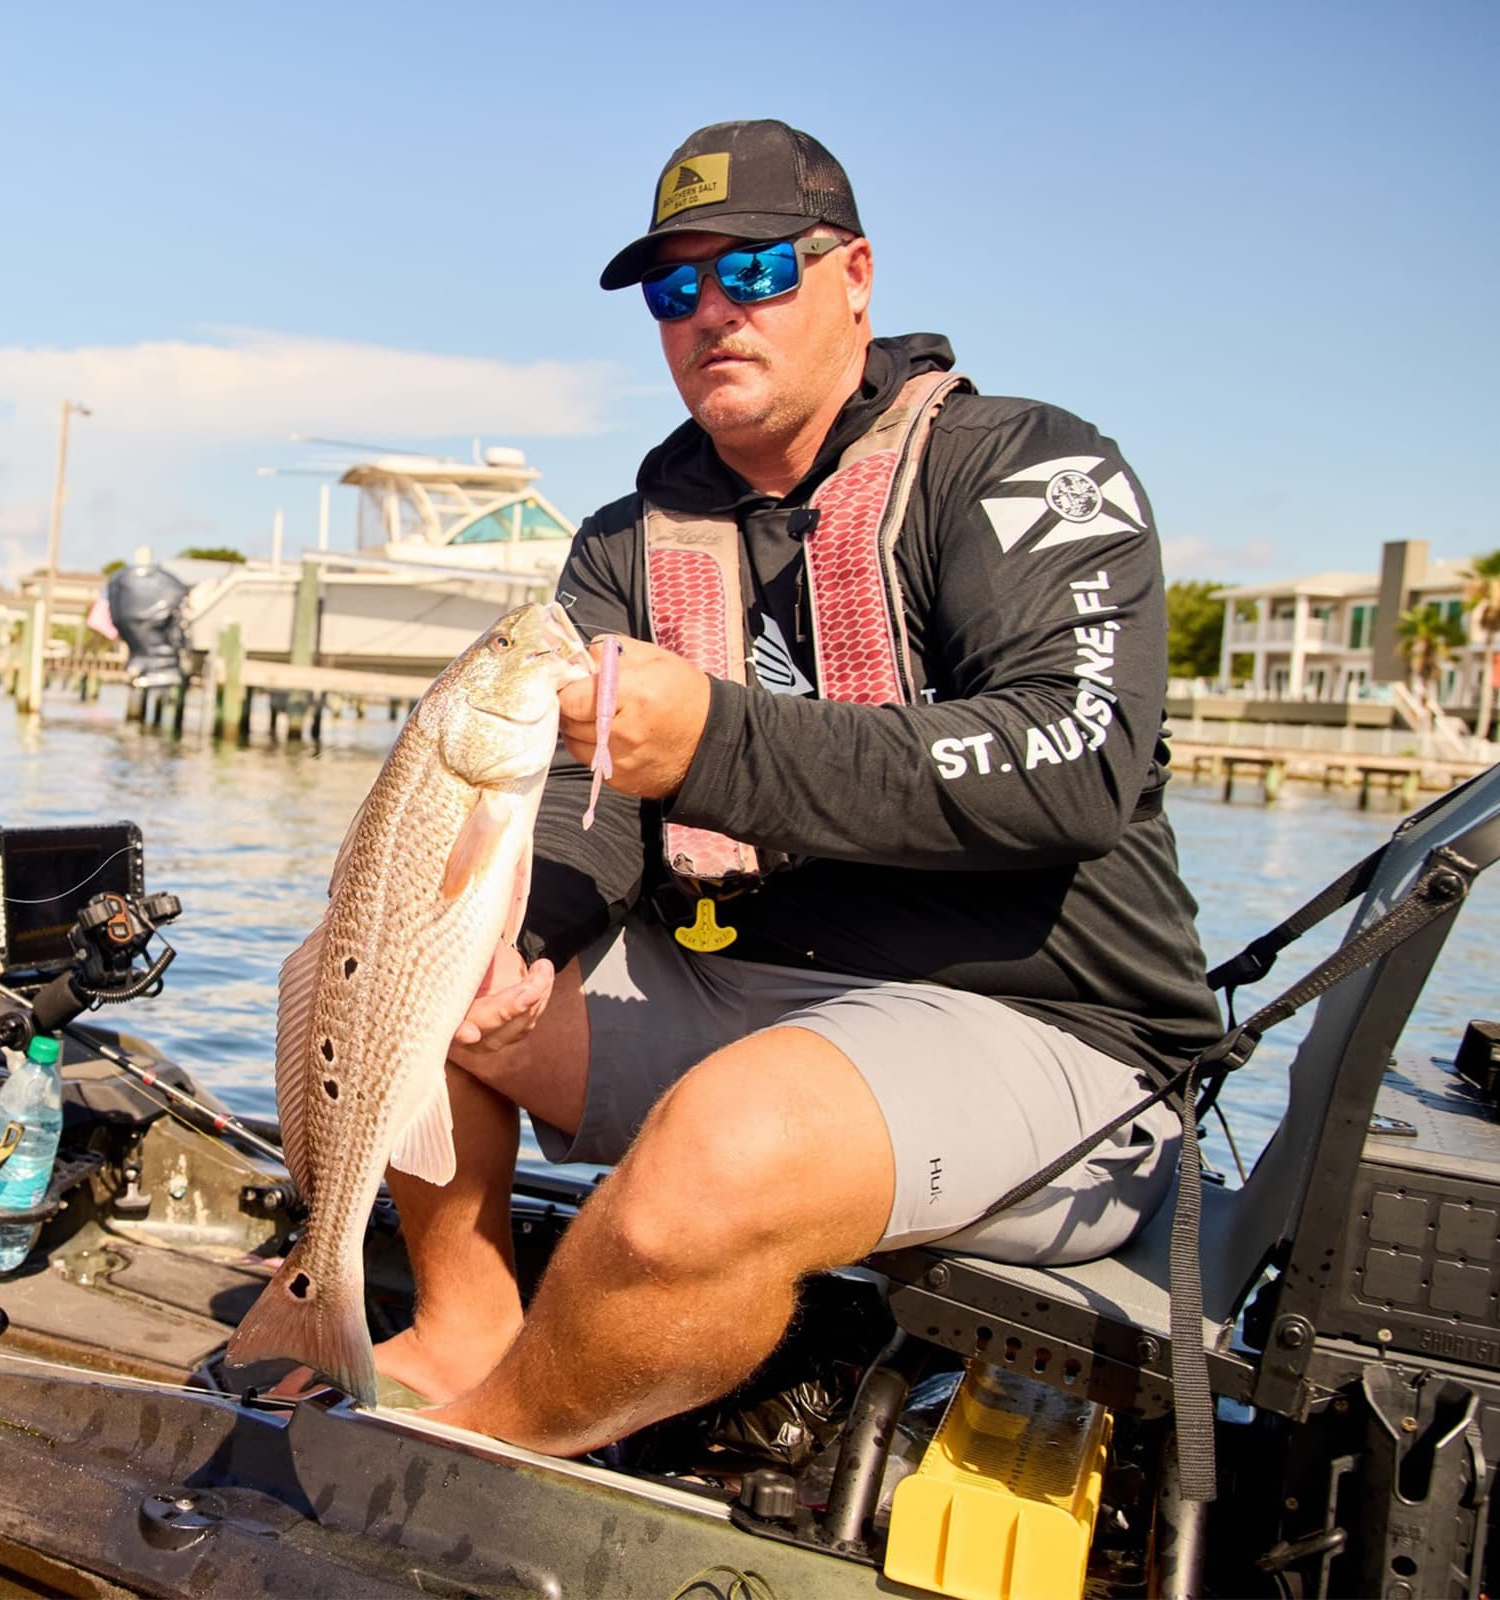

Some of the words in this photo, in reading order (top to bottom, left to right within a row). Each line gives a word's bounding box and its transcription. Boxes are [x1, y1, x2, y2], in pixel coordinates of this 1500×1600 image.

[698, 181, 718, 193] SALT
[931, 732, 1013, 780] ST.
[1069, 570, 1119, 615] FL
